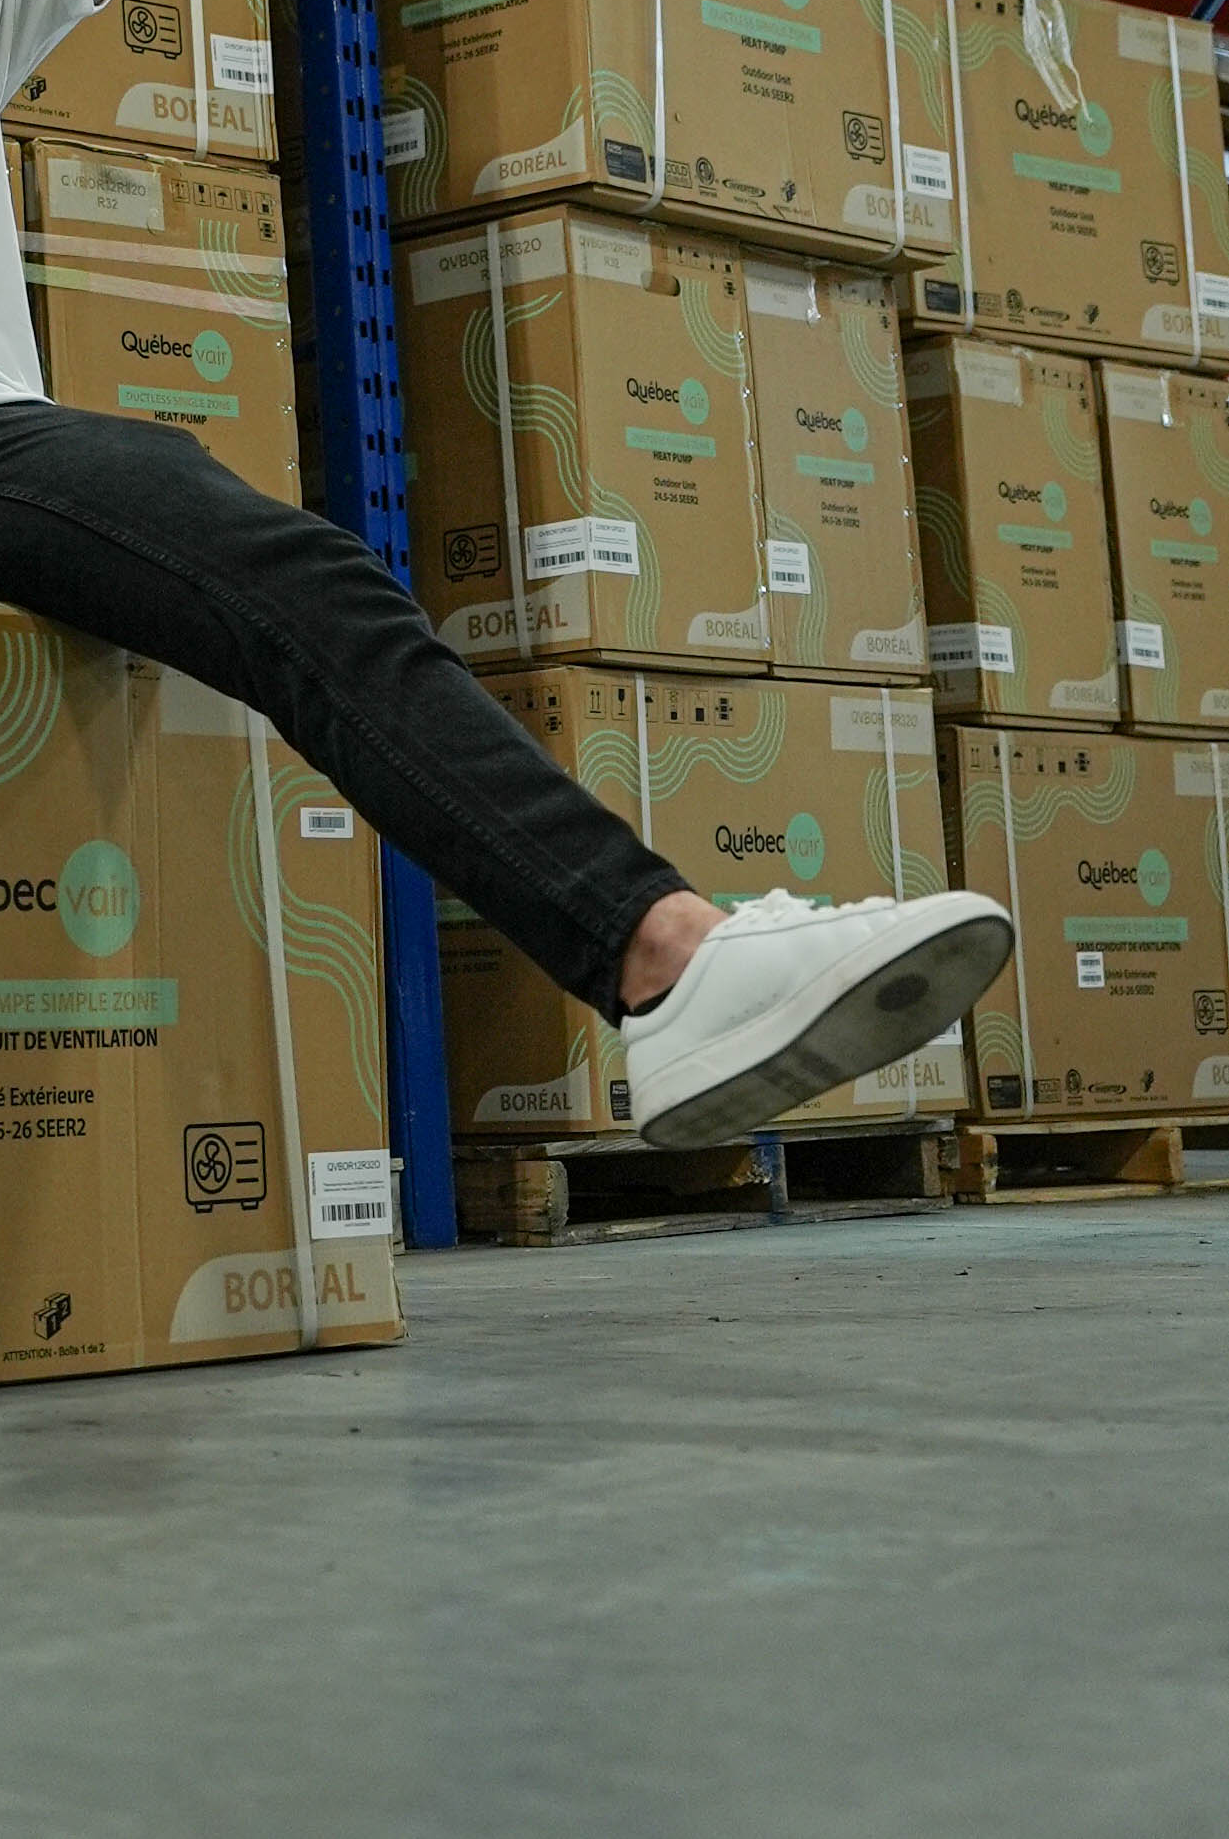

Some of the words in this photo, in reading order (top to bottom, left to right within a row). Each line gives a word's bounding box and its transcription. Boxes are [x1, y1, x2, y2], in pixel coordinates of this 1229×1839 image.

[1015, 98, 1078, 131] Québec
[498, 151, 568, 180] BORÉAL
[97, 197, 118, 210] R32
[121, 330, 192, 360] Québec
[194, 345, 227, 367] vair
[626, 377, 680, 404] Québec
[154, 410, 177, 423] HEAT
[180, 412, 207, 426] PUMP
[795, 408, 842, 433] Québec
[998, 480, 1042, 505] Québec
[705, 617, 759, 641] BORÉAL
[866, 636, 913, 656] BORÉAL
[716, 824, 785, 860] Québec
[1078, 860, 1138, 891] Québec
[65, 877, 129, 917] vair
[42, 989, 108, 1013] SIMPLE
[112, 989, 161, 1012] ZONE
[24, 1030, 47, 1051] DE
[50, 1027, 158, 1050] VENTILATION
[10, 1086, 95, 1107] Extérieure
[500, 1087, 573, 1112] BORÉAL
[36, 1117, 87, 1139] SEER2
[224, 1262, 366, 1314] BORAL
[3, 1348, 52, 1362] ATTENTION
